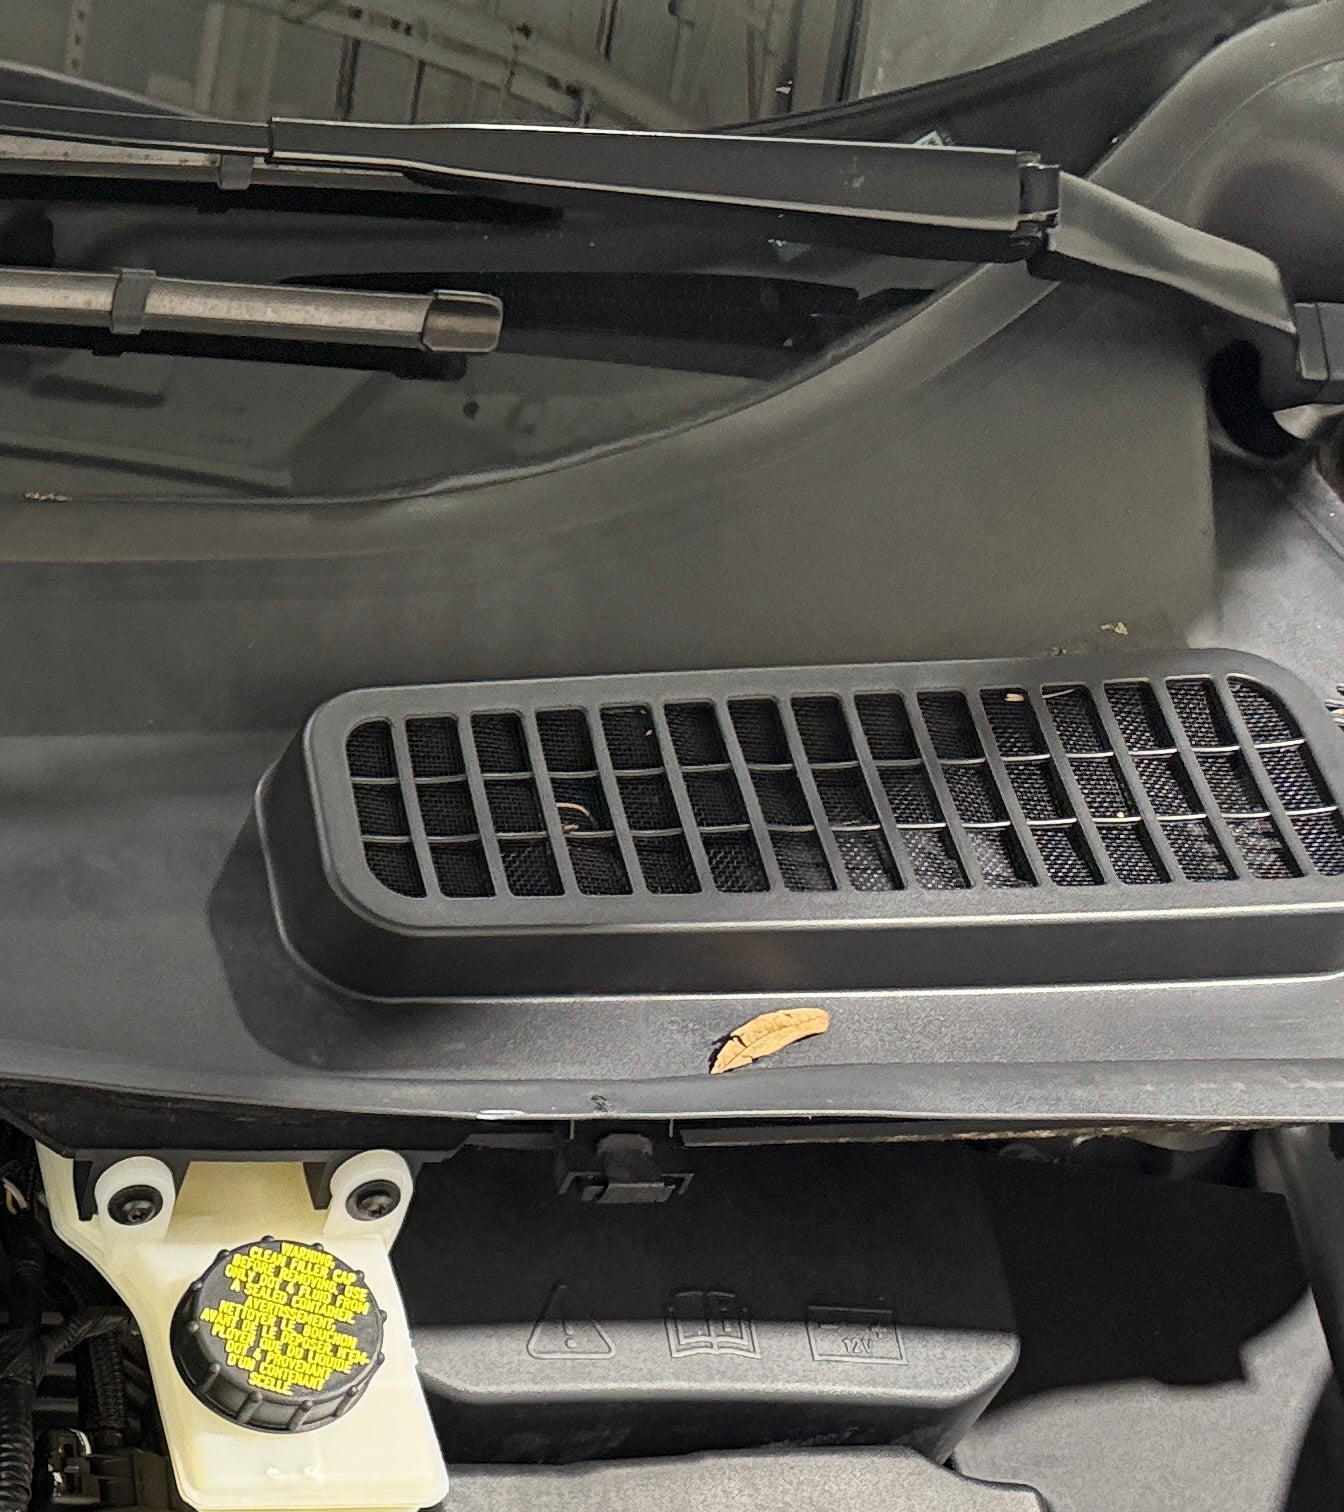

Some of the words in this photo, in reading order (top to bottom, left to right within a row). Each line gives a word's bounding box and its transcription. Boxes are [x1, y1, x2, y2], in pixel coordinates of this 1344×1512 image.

[232, 1254, 276, 1277] BEFORE
[344, 1285, 369, 1302] USE
[249, 1246, 287, 1267] CLEAN
[289, 1257, 330, 1279] FILLER
[332, 1268, 357, 1286] CAP
[224, 1263, 256, 1283] ONLY
[258, 1273, 282, 1290] DOT
[286, 1281, 295, 1294] 4
[298, 1285, 332, 1304] FLUID
[335, 1295, 370, 1316] FROM
[230, 1278, 241, 1293] A
[244, 1282, 288, 1305] SEALED
[200, 1307, 239, 1328] AVANT
[241, 1319, 258, 1332] DE
[261, 1325, 278, 1339] LE
[219, 1300, 277, 1328] NETTOYER
[280, 1318, 297, 1331] LE
[302, 1324, 358, 1350] BOUCHON
[211, 1323, 256, 1346] PLOYER
[259, 1337, 283, 1354] QUE
[286, 1344, 304, 1359] DU
[307, 1349, 354, 1375] LIQUIDE
[225, 1340, 250, 1355] DOT
[252, 1347, 262, 1361] 4
[265, 1351, 334, 1380] PROVENANT
[841, 1336, 873, 1355] 12V
[227, 1352, 256, 1371] D'UN
[259, 1361, 327, 1392] CONTENANT
